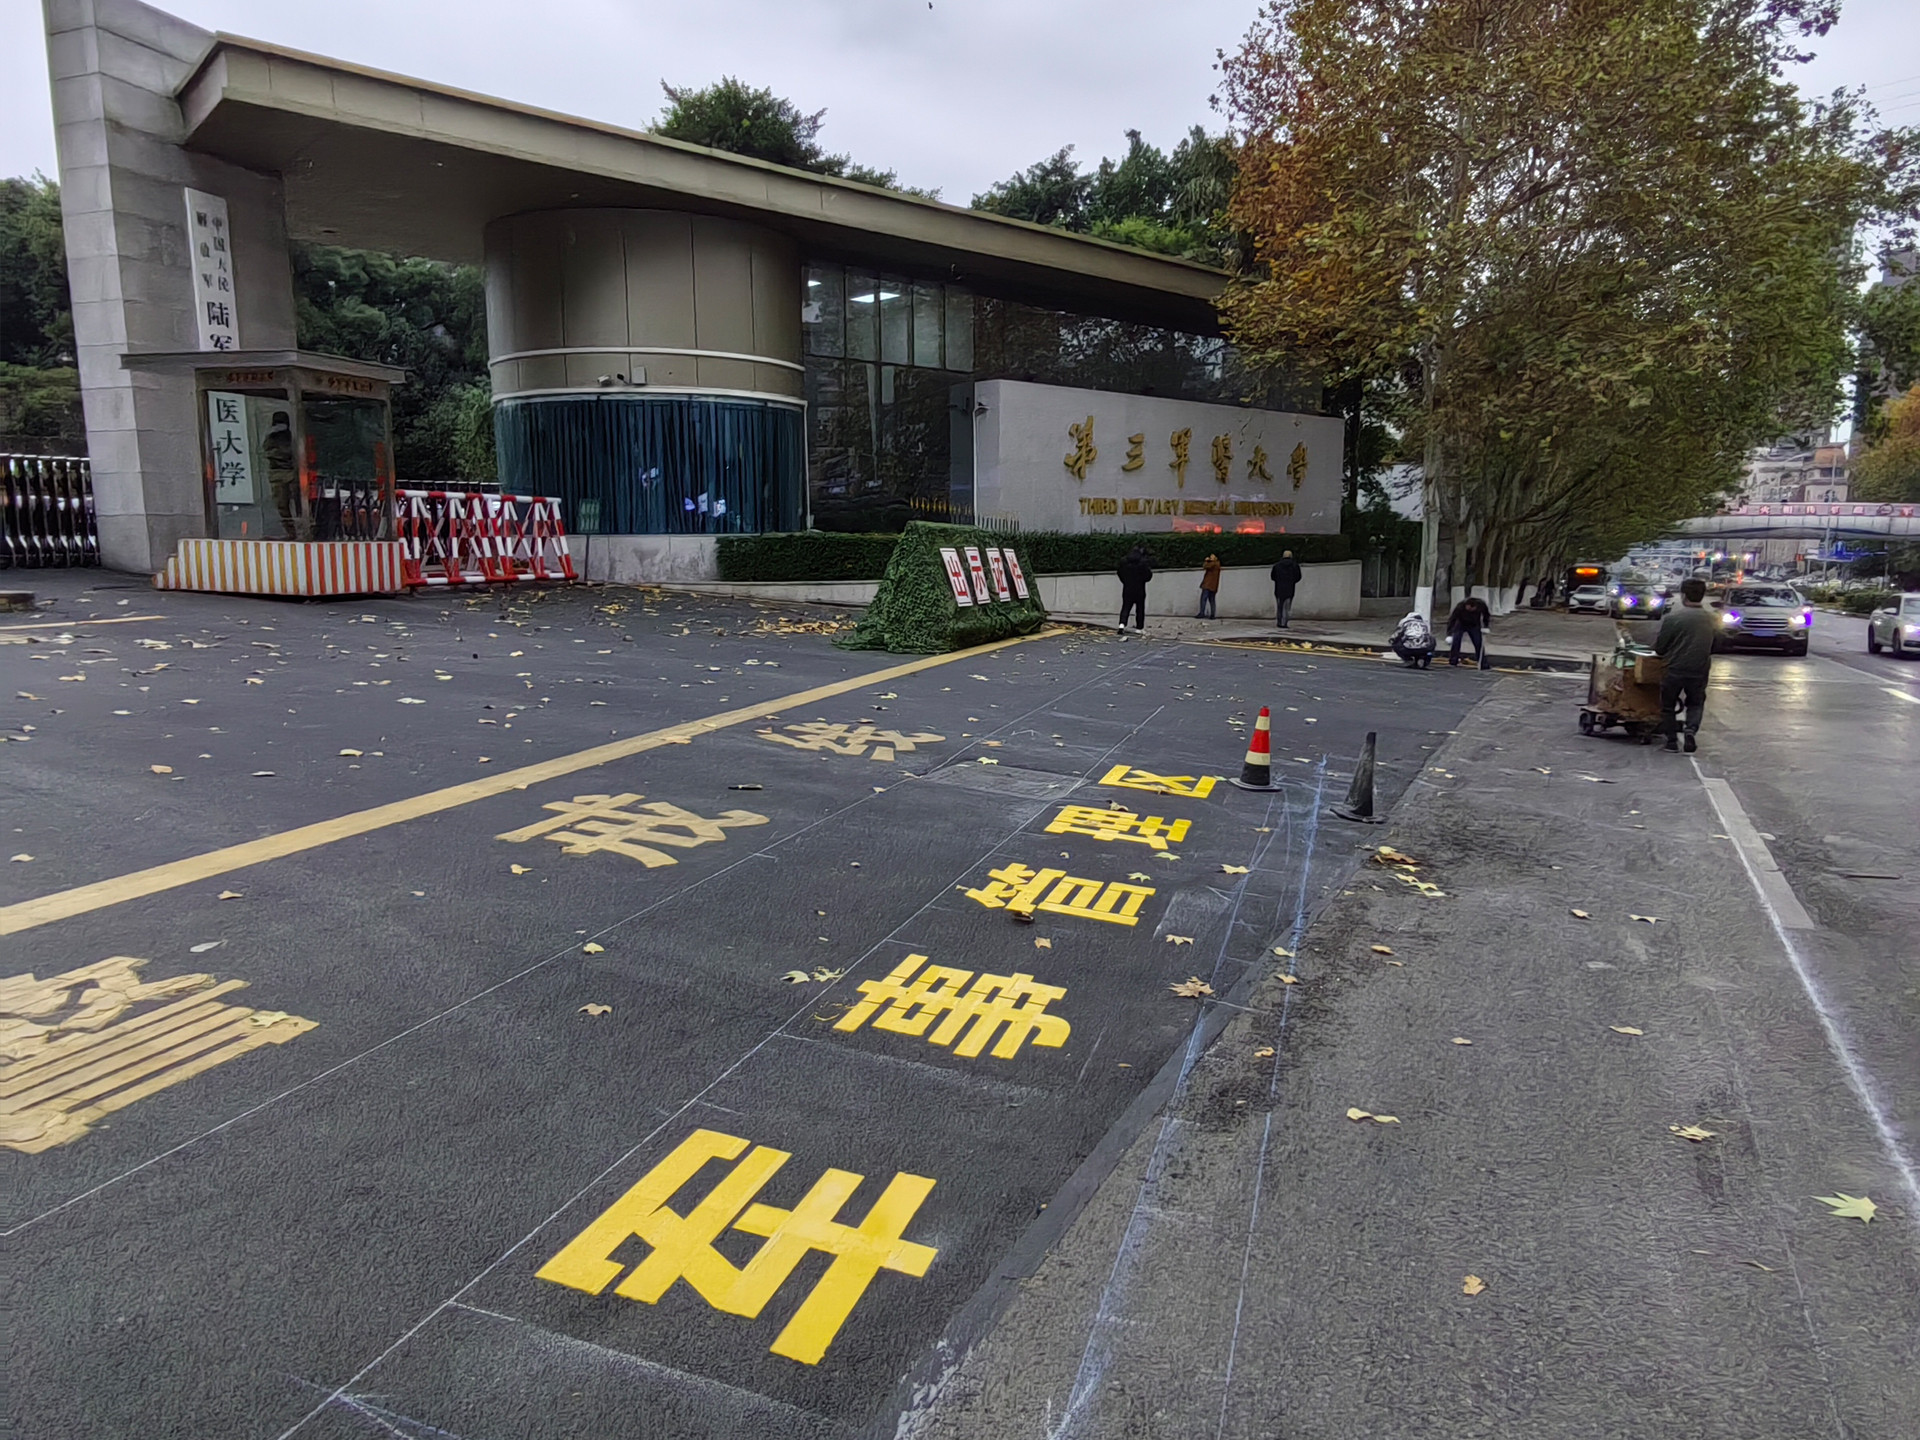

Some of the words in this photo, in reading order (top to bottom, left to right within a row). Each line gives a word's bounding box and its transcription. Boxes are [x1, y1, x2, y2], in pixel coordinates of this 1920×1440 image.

[534, 764, 1218, 1365] 军事管理区
